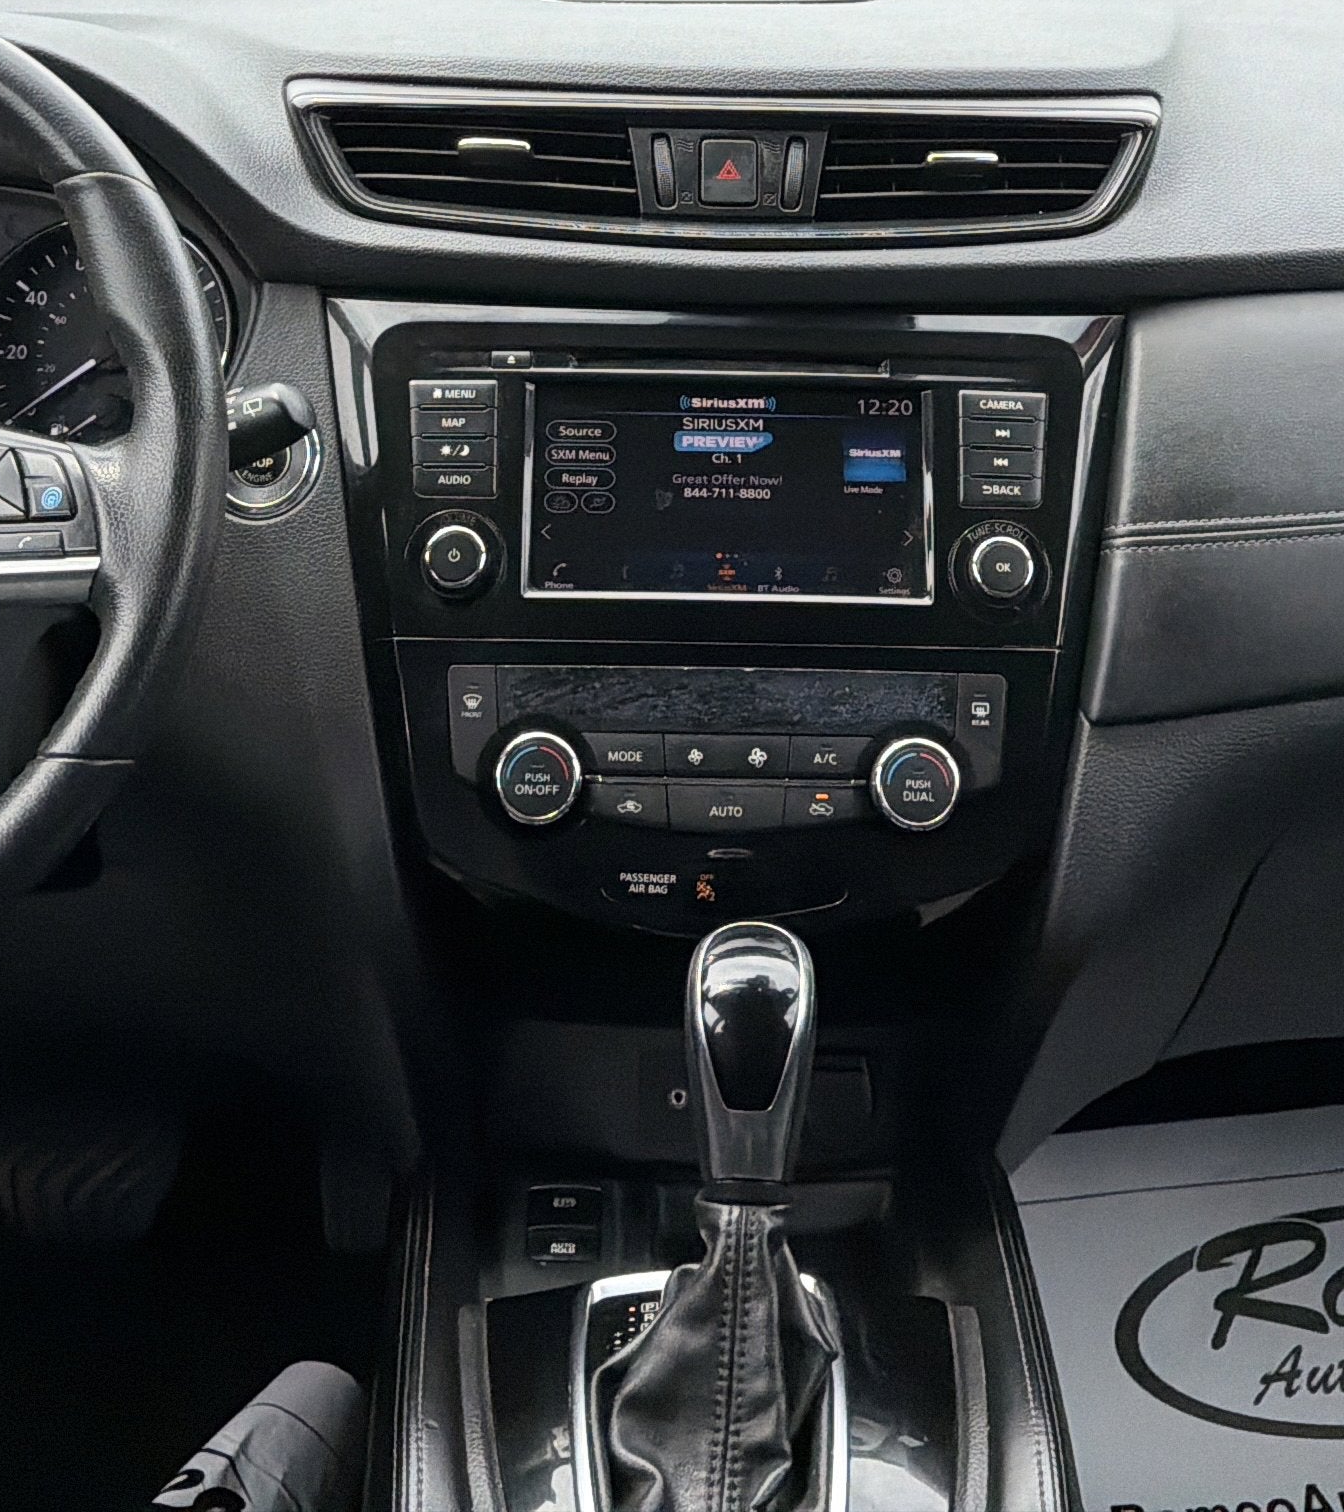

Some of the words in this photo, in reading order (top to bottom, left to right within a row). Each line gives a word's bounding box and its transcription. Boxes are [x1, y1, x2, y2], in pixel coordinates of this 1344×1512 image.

[24, 290, 48, 306] 40
[6, 344, 28, 360] 20
[445, 389, 477, 399] MENU
[857, 398, 914, 416] 12:20
[979, 399, 1024, 410] CAMERA
[441, 417, 466, 427] MAP
[559, 425, 603, 437] Source
[681, 435, 765, 448] PREVIEW
[550, 449, 576, 460] SXM
[578, 449, 610, 461] Menu
[711, 453, 732, 464] Ch.
[736, 453, 743, 464] 1
[437, 475, 472, 485] AUDIO
[561, 472, 599, 487] Replay
[672, 473, 709, 484] Great
[711, 474, 745, 485] Offer
[749, 475, 783, 486] Now!
[683, 487, 772, 499] 844-711-8800
[992, 485, 1022, 496] BACK
[995, 562, 1012, 573] OK
[544, 581, 574, 590] Phone
[757, 584, 769, 593] BT
[771, 584, 800, 593] Audio
[878, 586, 911, 596] Settings
[607, 750, 644, 762] MODE
[813, 753, 838, 766] A/C
[524, 772, 551, 783] PUSH
[905, 778, 932, 789] PUSH
[902, 790, 936, 803] DUAL
[708, 806, 743, 818] AUTO
[619, 872, 678, 884] PASSENGER
[628, 884, 646, 894] AIR
[647, 884, 669, 895] BAG
